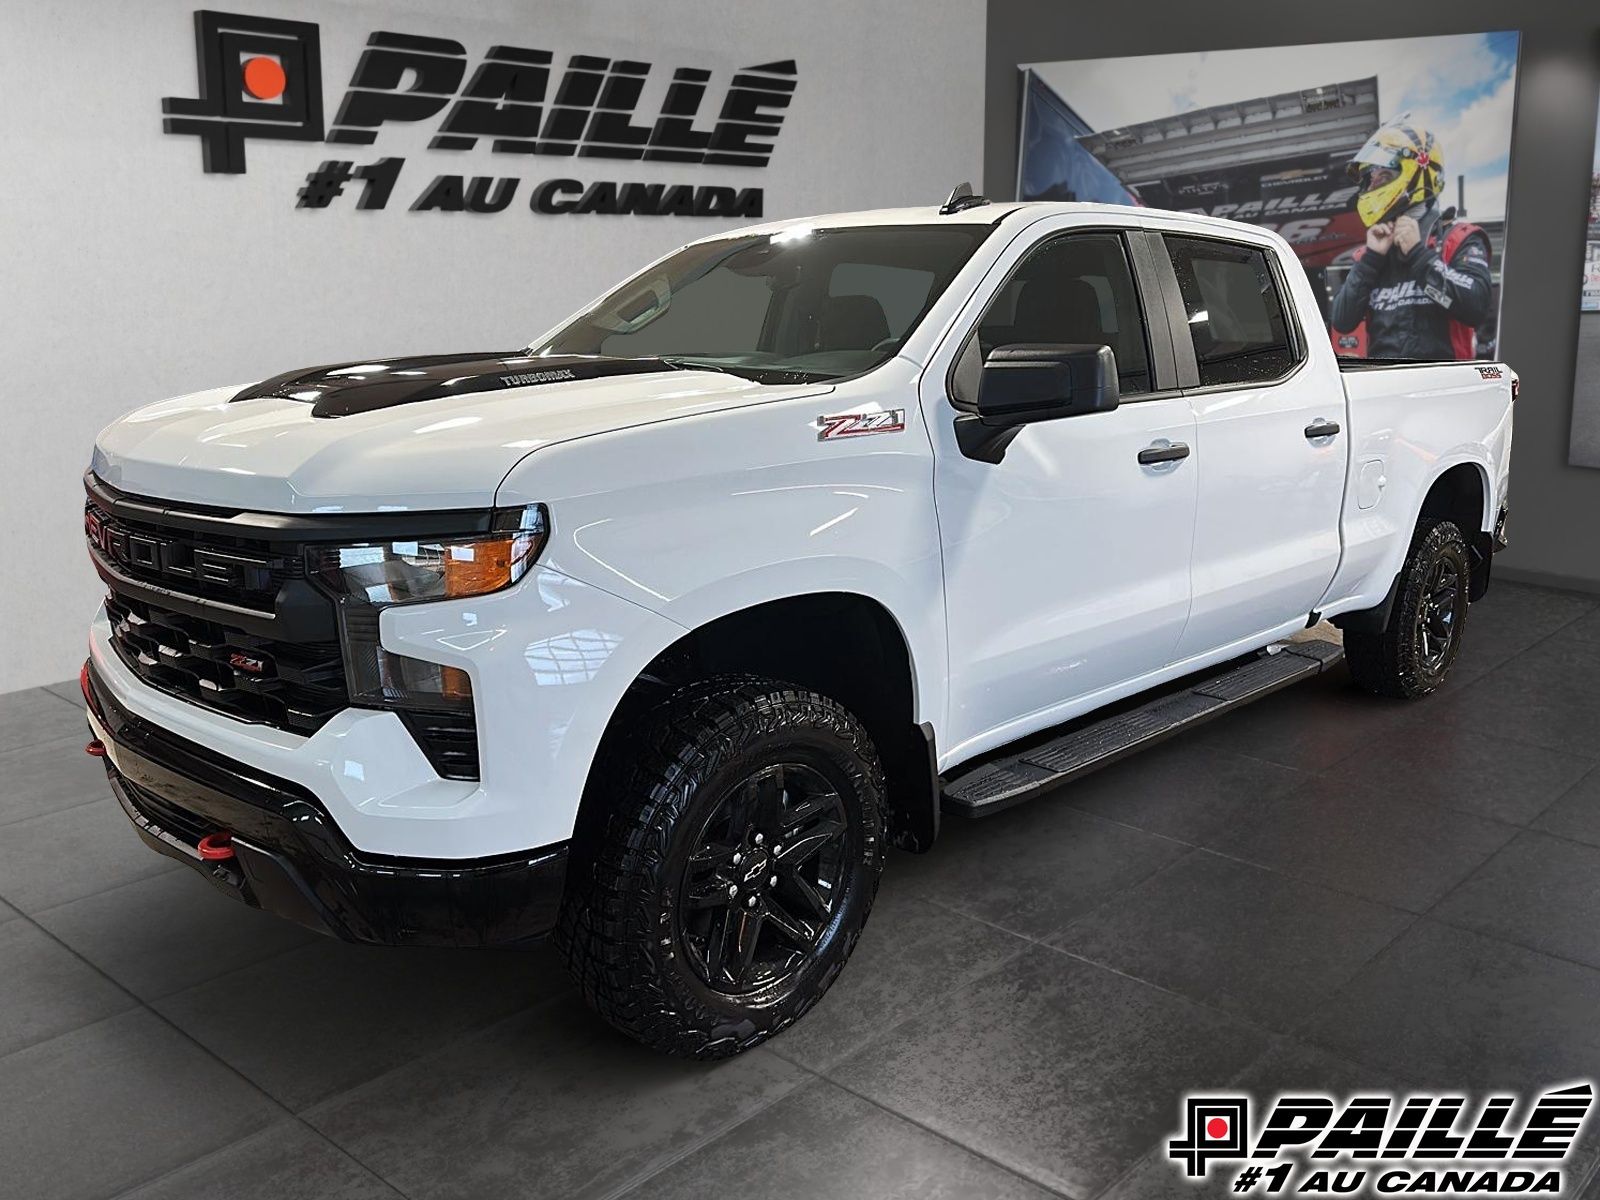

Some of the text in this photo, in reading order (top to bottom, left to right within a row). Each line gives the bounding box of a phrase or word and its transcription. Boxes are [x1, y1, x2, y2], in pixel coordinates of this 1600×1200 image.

[325, 31, 797, 168] PAILLÉ
[296, 157, 764, 218] #1 AU CANADA
[500, 369, 576, 387] TURBOMAX
